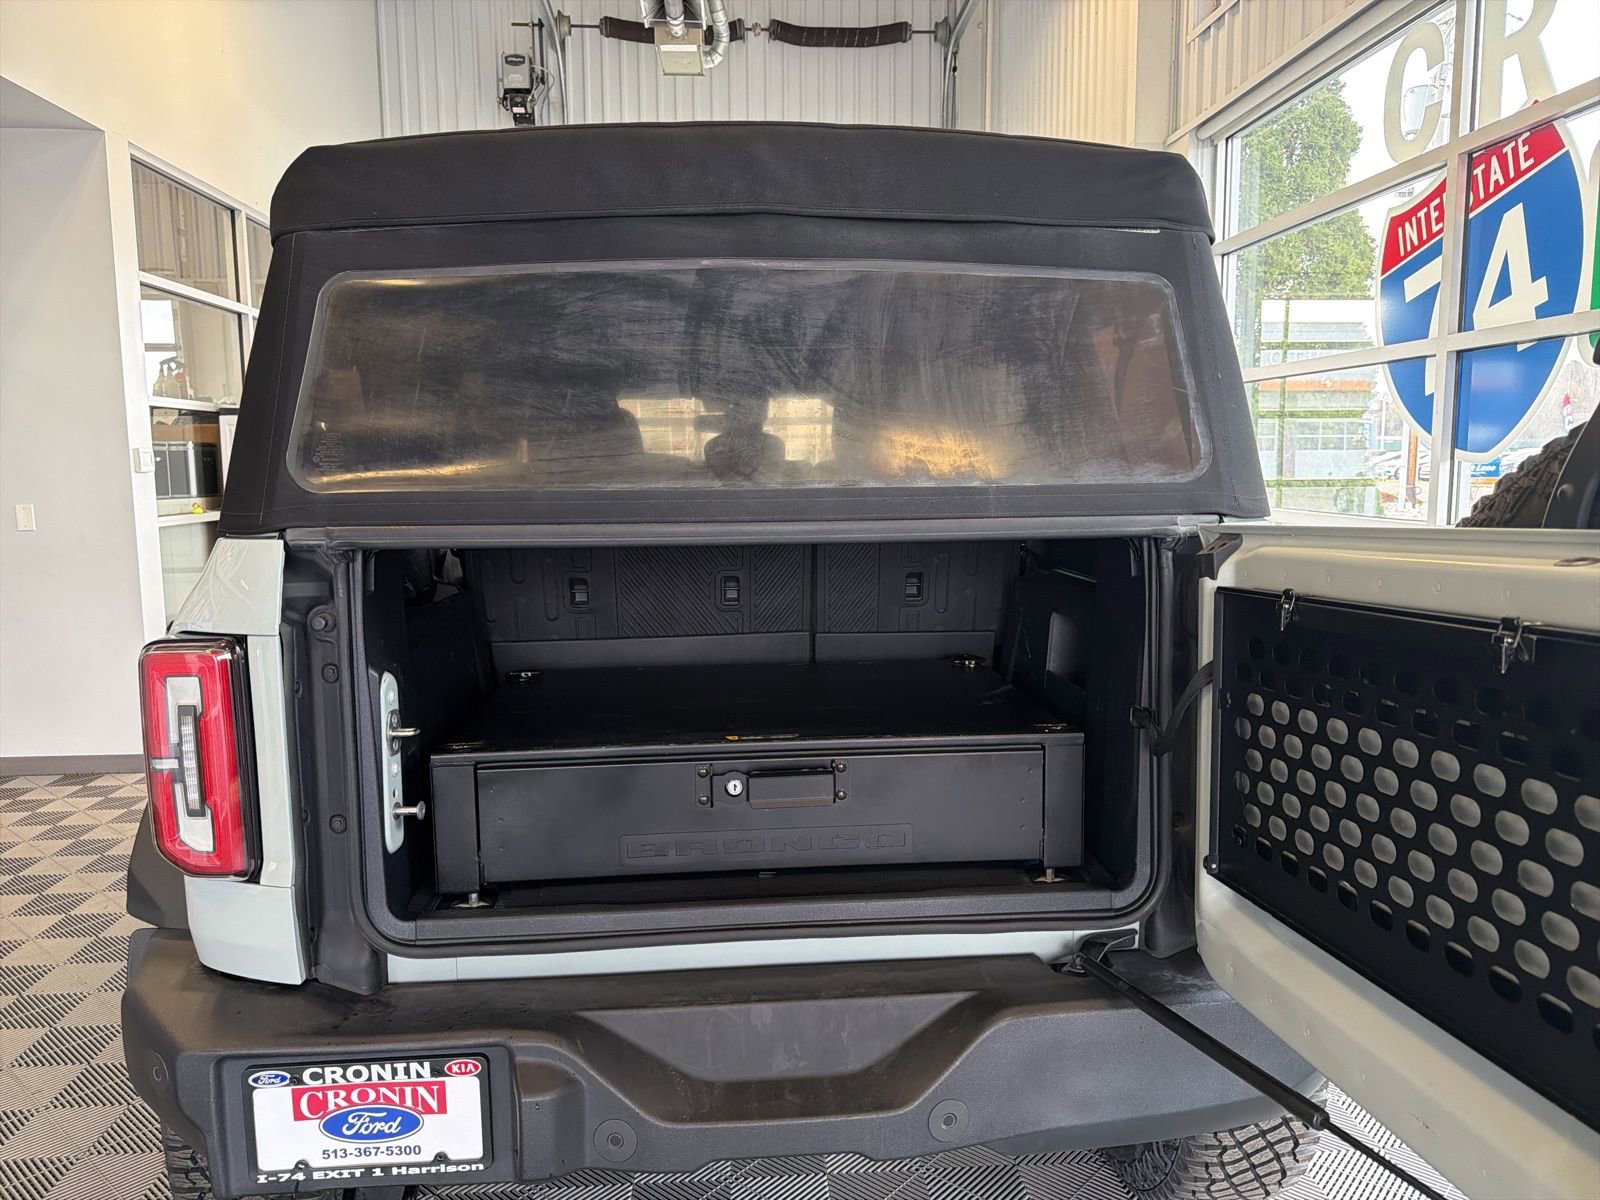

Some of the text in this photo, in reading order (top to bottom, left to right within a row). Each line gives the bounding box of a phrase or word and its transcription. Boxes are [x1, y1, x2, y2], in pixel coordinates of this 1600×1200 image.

[1397, 132, 1535, 257] INTETATE
[1404, 203, 1549, 397] 74
[626, 831, 906, 859] BRONCO
[258, 1073, 282, 1085] Ford
[302, 1062, 431, 1085] CRONIN
[451, 1063, 476, 1074] KIA
[300, 1085, 440, 1119] CRONIN
[341, 1111, 402, 1136] Ford
[321, 1144, 422, 1160] 513-367-5300
[256, 1163, 484, 1184] I-74 EXIT 1 Harrison
